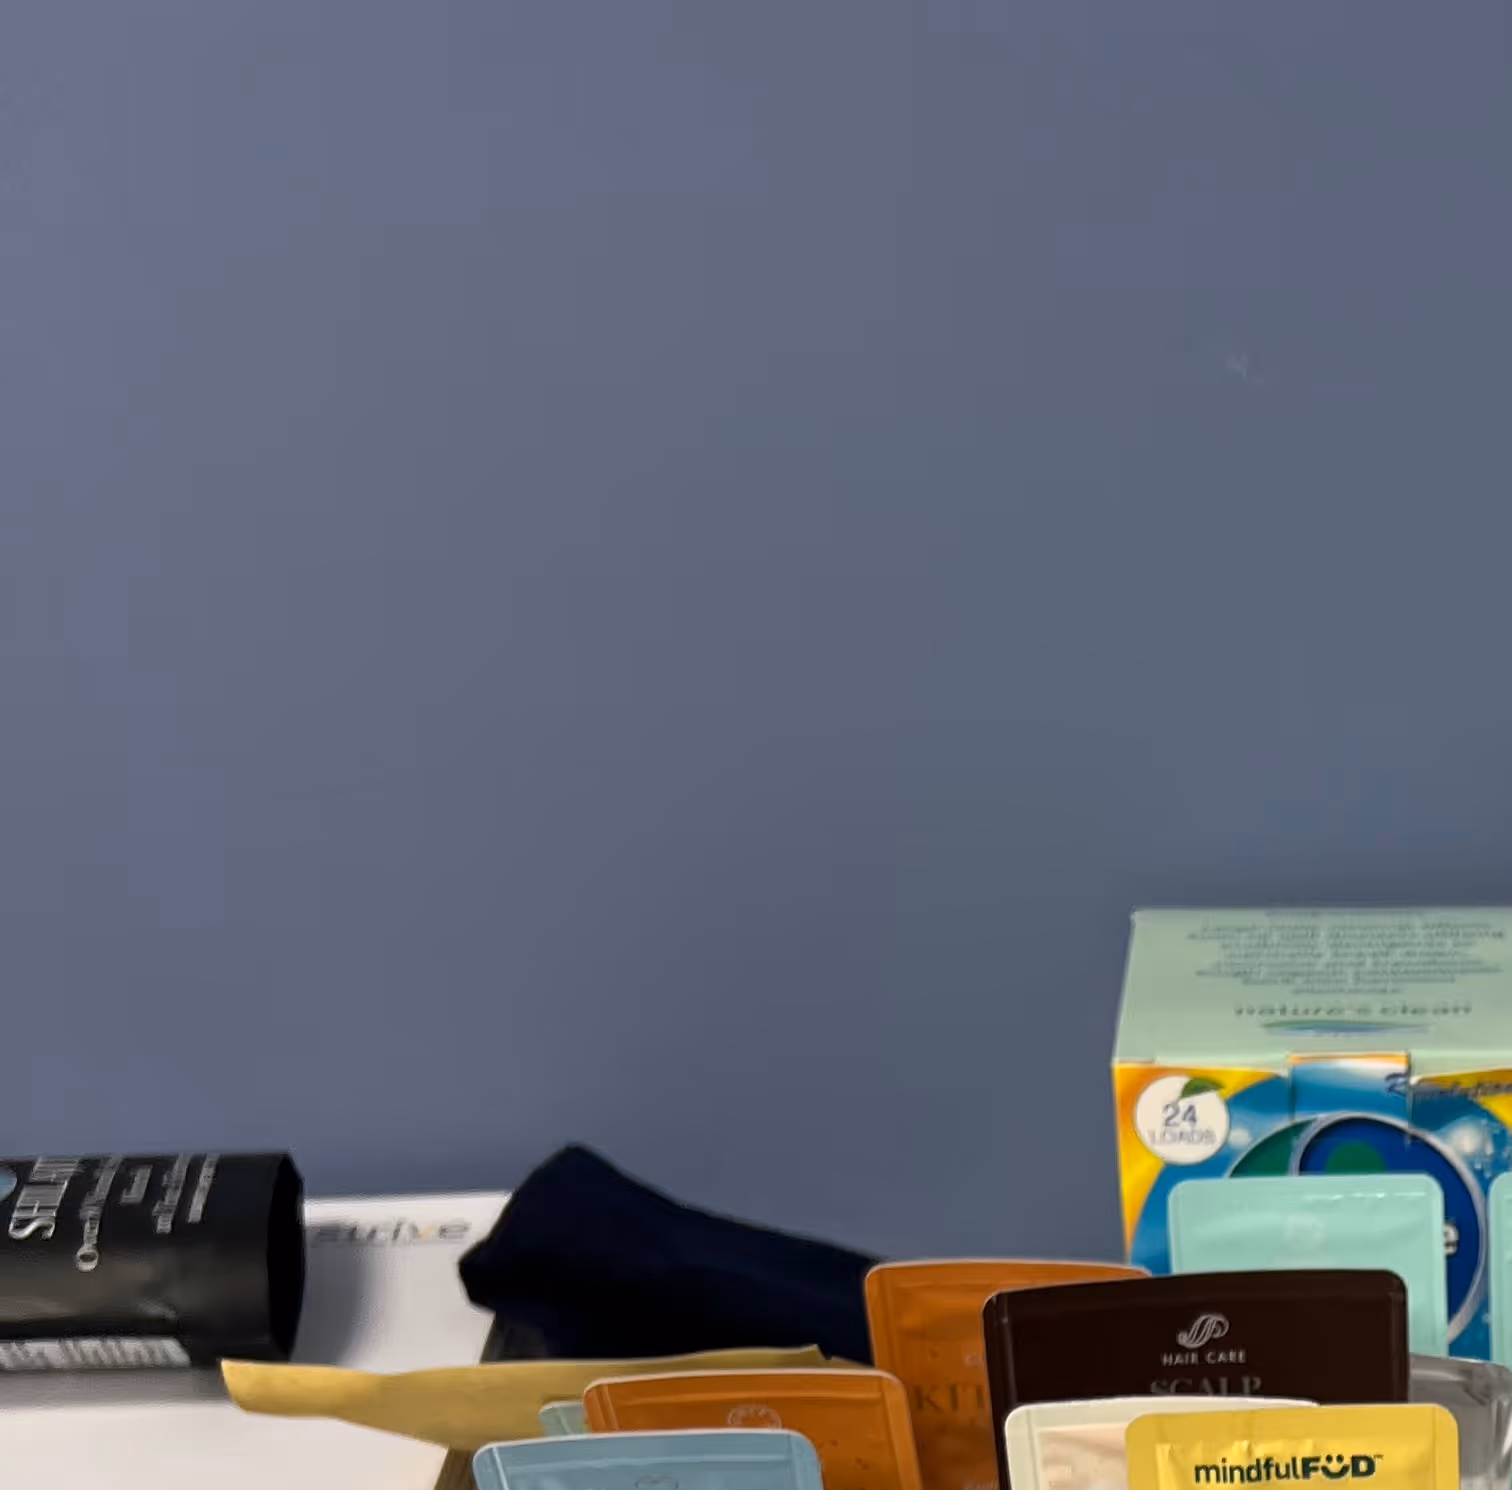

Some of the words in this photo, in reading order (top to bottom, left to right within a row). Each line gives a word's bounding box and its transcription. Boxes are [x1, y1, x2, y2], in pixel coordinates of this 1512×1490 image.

[1162, 1103, 1198, 1128] 24
[1161, 1352, 1199, 1366] HAIR
[1206, 1349, 1247, 1364] CARE
